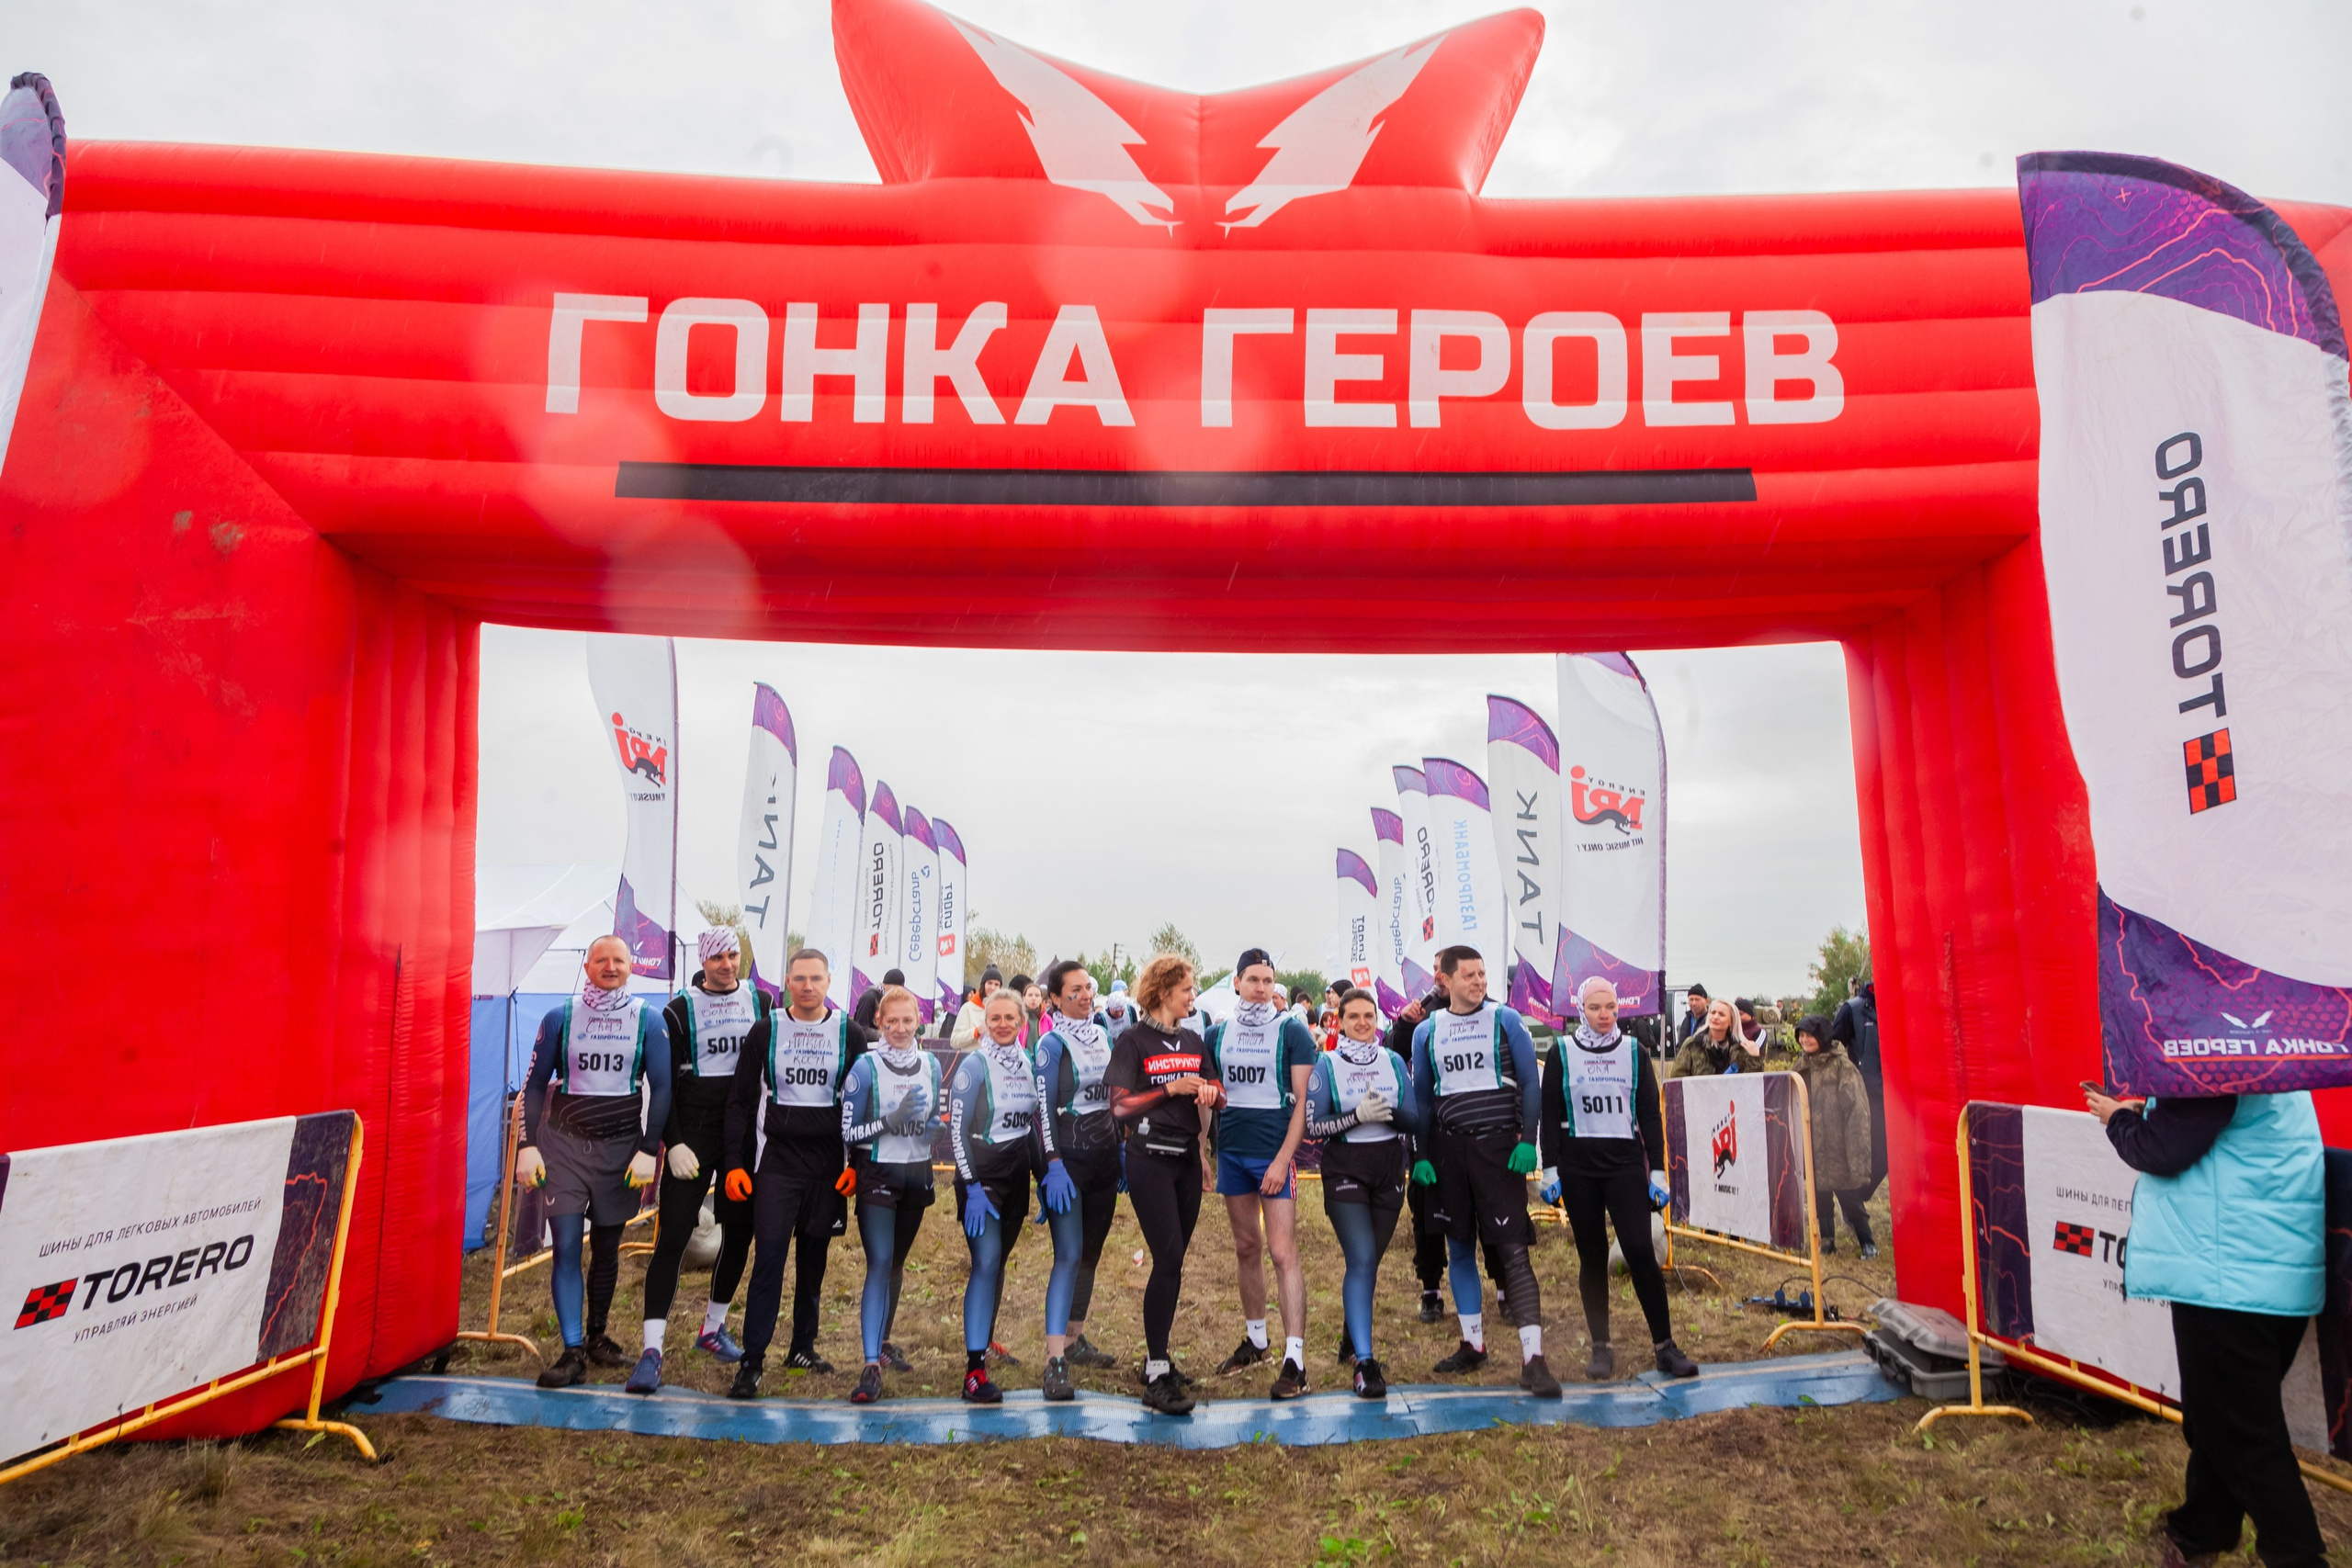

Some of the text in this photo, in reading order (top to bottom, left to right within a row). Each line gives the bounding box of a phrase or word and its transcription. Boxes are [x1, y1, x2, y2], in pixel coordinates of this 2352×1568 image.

[546, 292, 1845, 430] ГОНКА ГЕРОЕВ
[578, 1053, 624, 1072] 5013
[1148, 1057, 1201, 1072] ИНСТРУКТО
[1443, 1052, 1484, 1073] 5012
[786, 1066, 828, 1086] 5009
[1227, 1065, 1266, 1084] 5007
[1084, 1083, 1110, 1100] 500
[1036, 1075, 1055, 1154] GAZPROMBANK
[1581, 1096, 1623, 1114] 5011
[951, 1098, 972, 1180] GAZPROMBANK
[2056, 1186, 2088, 1202] ШИНЫ
[2091, 1193, 2109, 1207] ДЛЯ
[39, 1198, 261, 1258] ШИНЫ ДЛЯ ЛЕГКОВЫХ АВТОМОБИЛЕЙ
[82, 1234, 254, 1311] TORERO
[74, 1293, 198, 1343] УПРАВЛЯЙ ЭНЕРГИЕЙ
